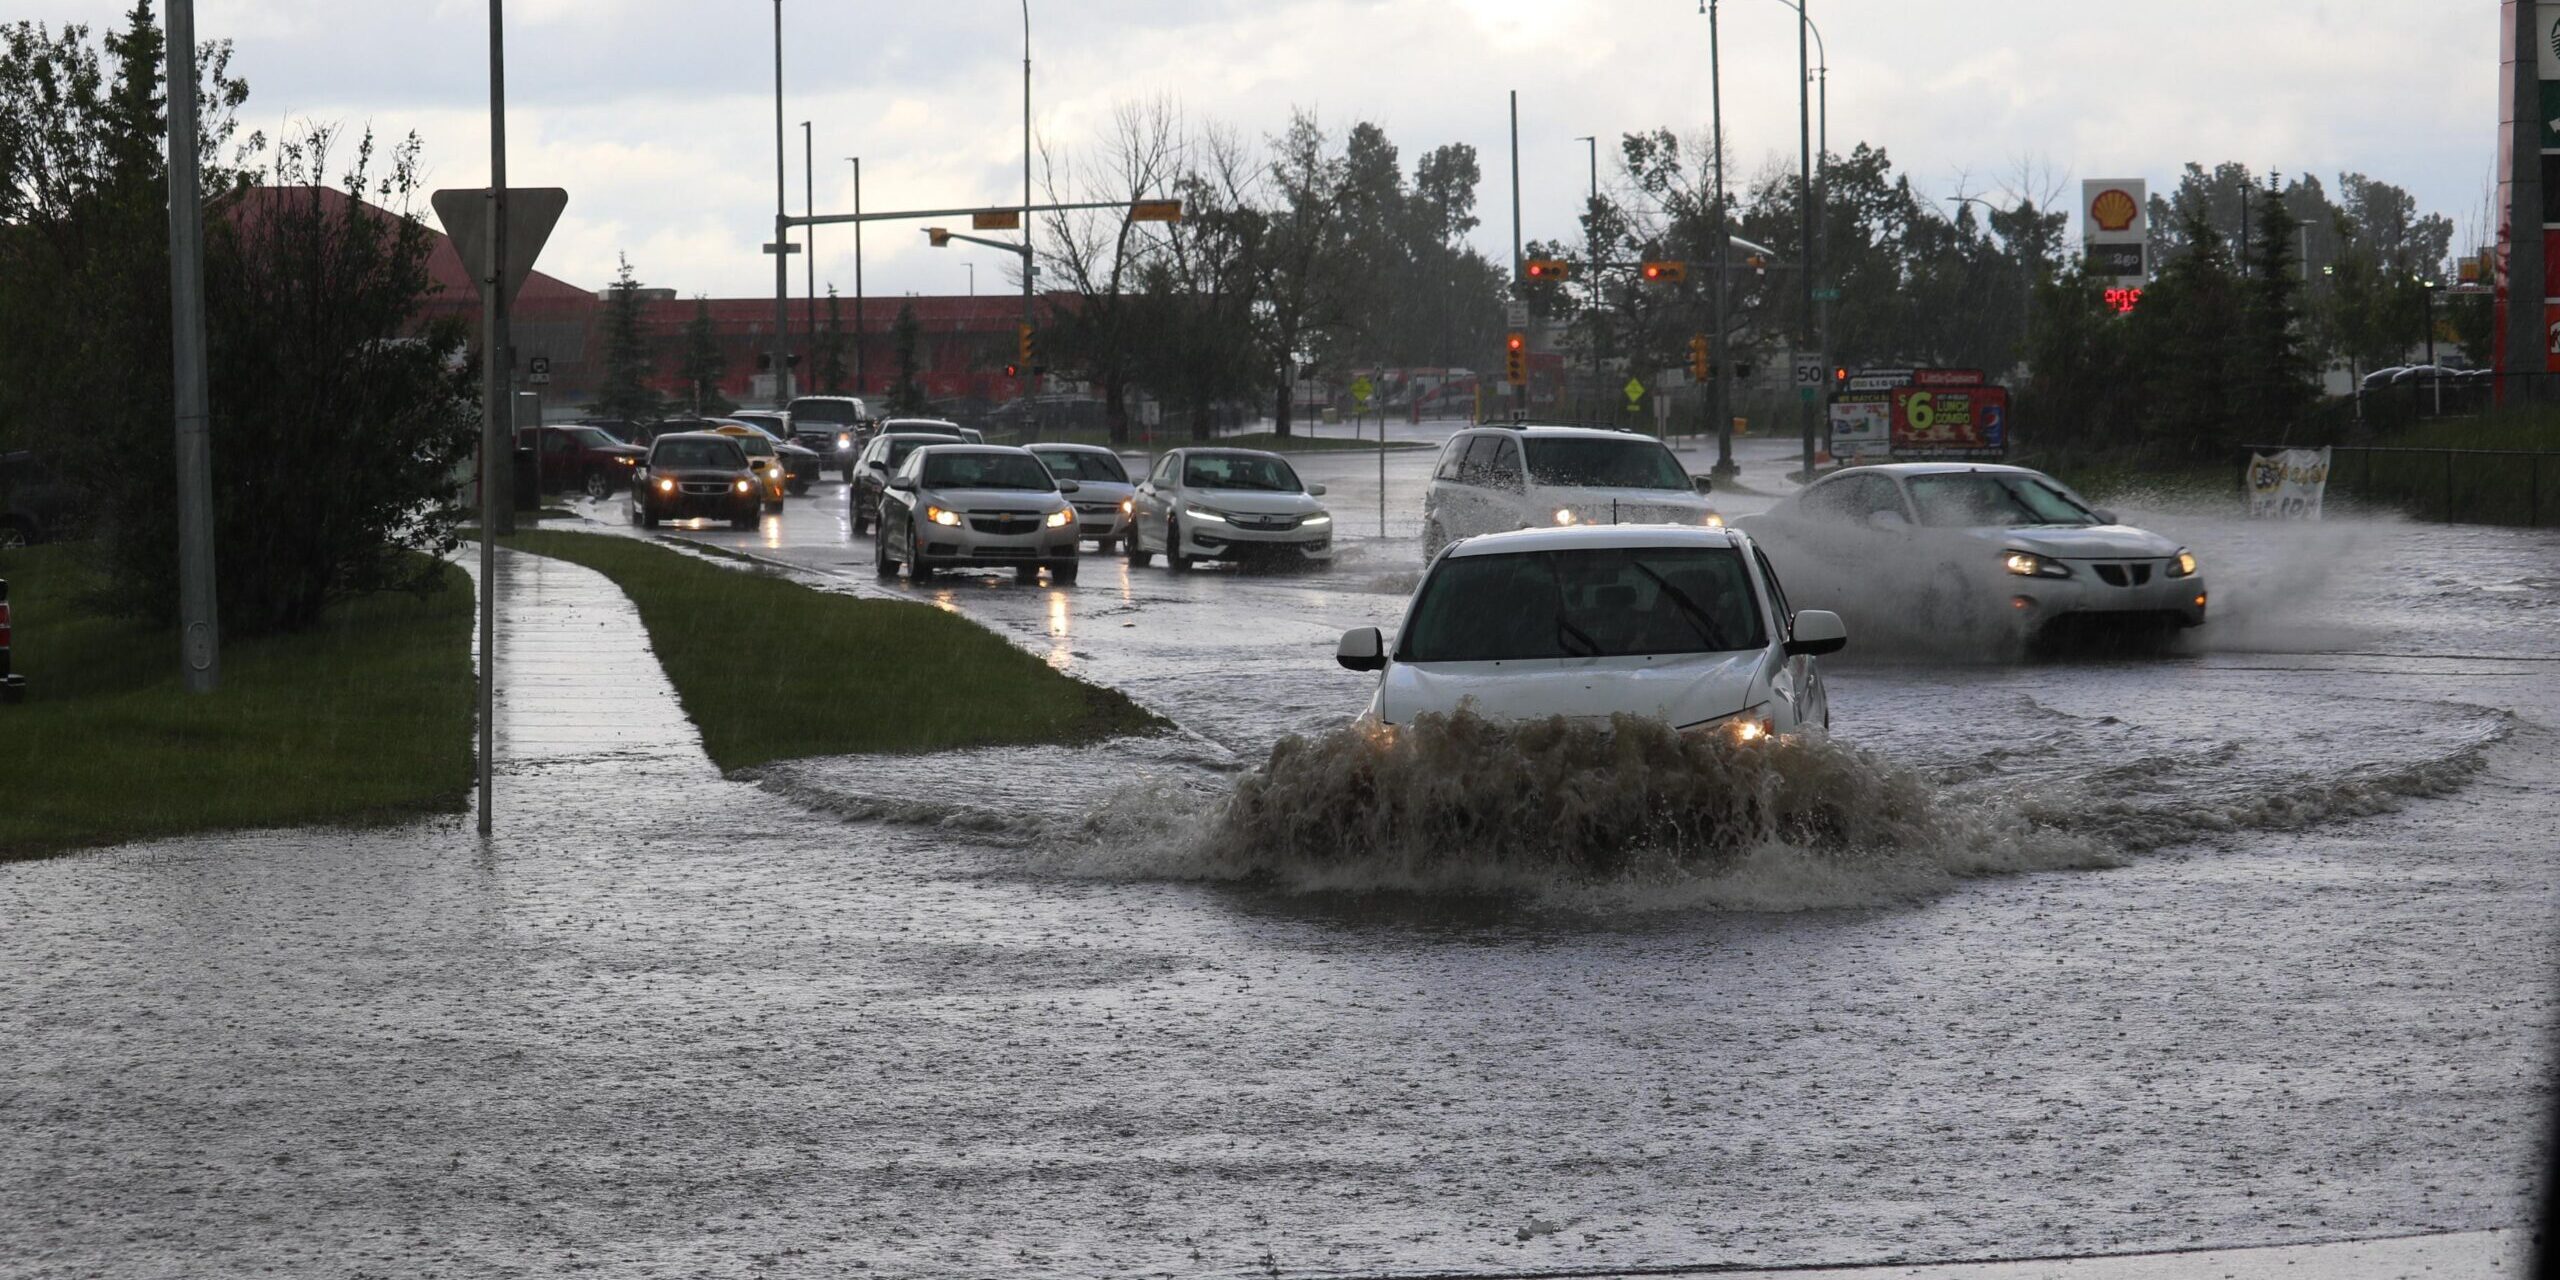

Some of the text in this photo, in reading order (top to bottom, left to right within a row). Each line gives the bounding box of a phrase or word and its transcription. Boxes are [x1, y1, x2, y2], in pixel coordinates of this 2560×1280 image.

[1798, 366, 1821, 382] 50
[1937, 401, 1969, 412] LUNCH
[1935, 413, 1970, 424] COMBO
